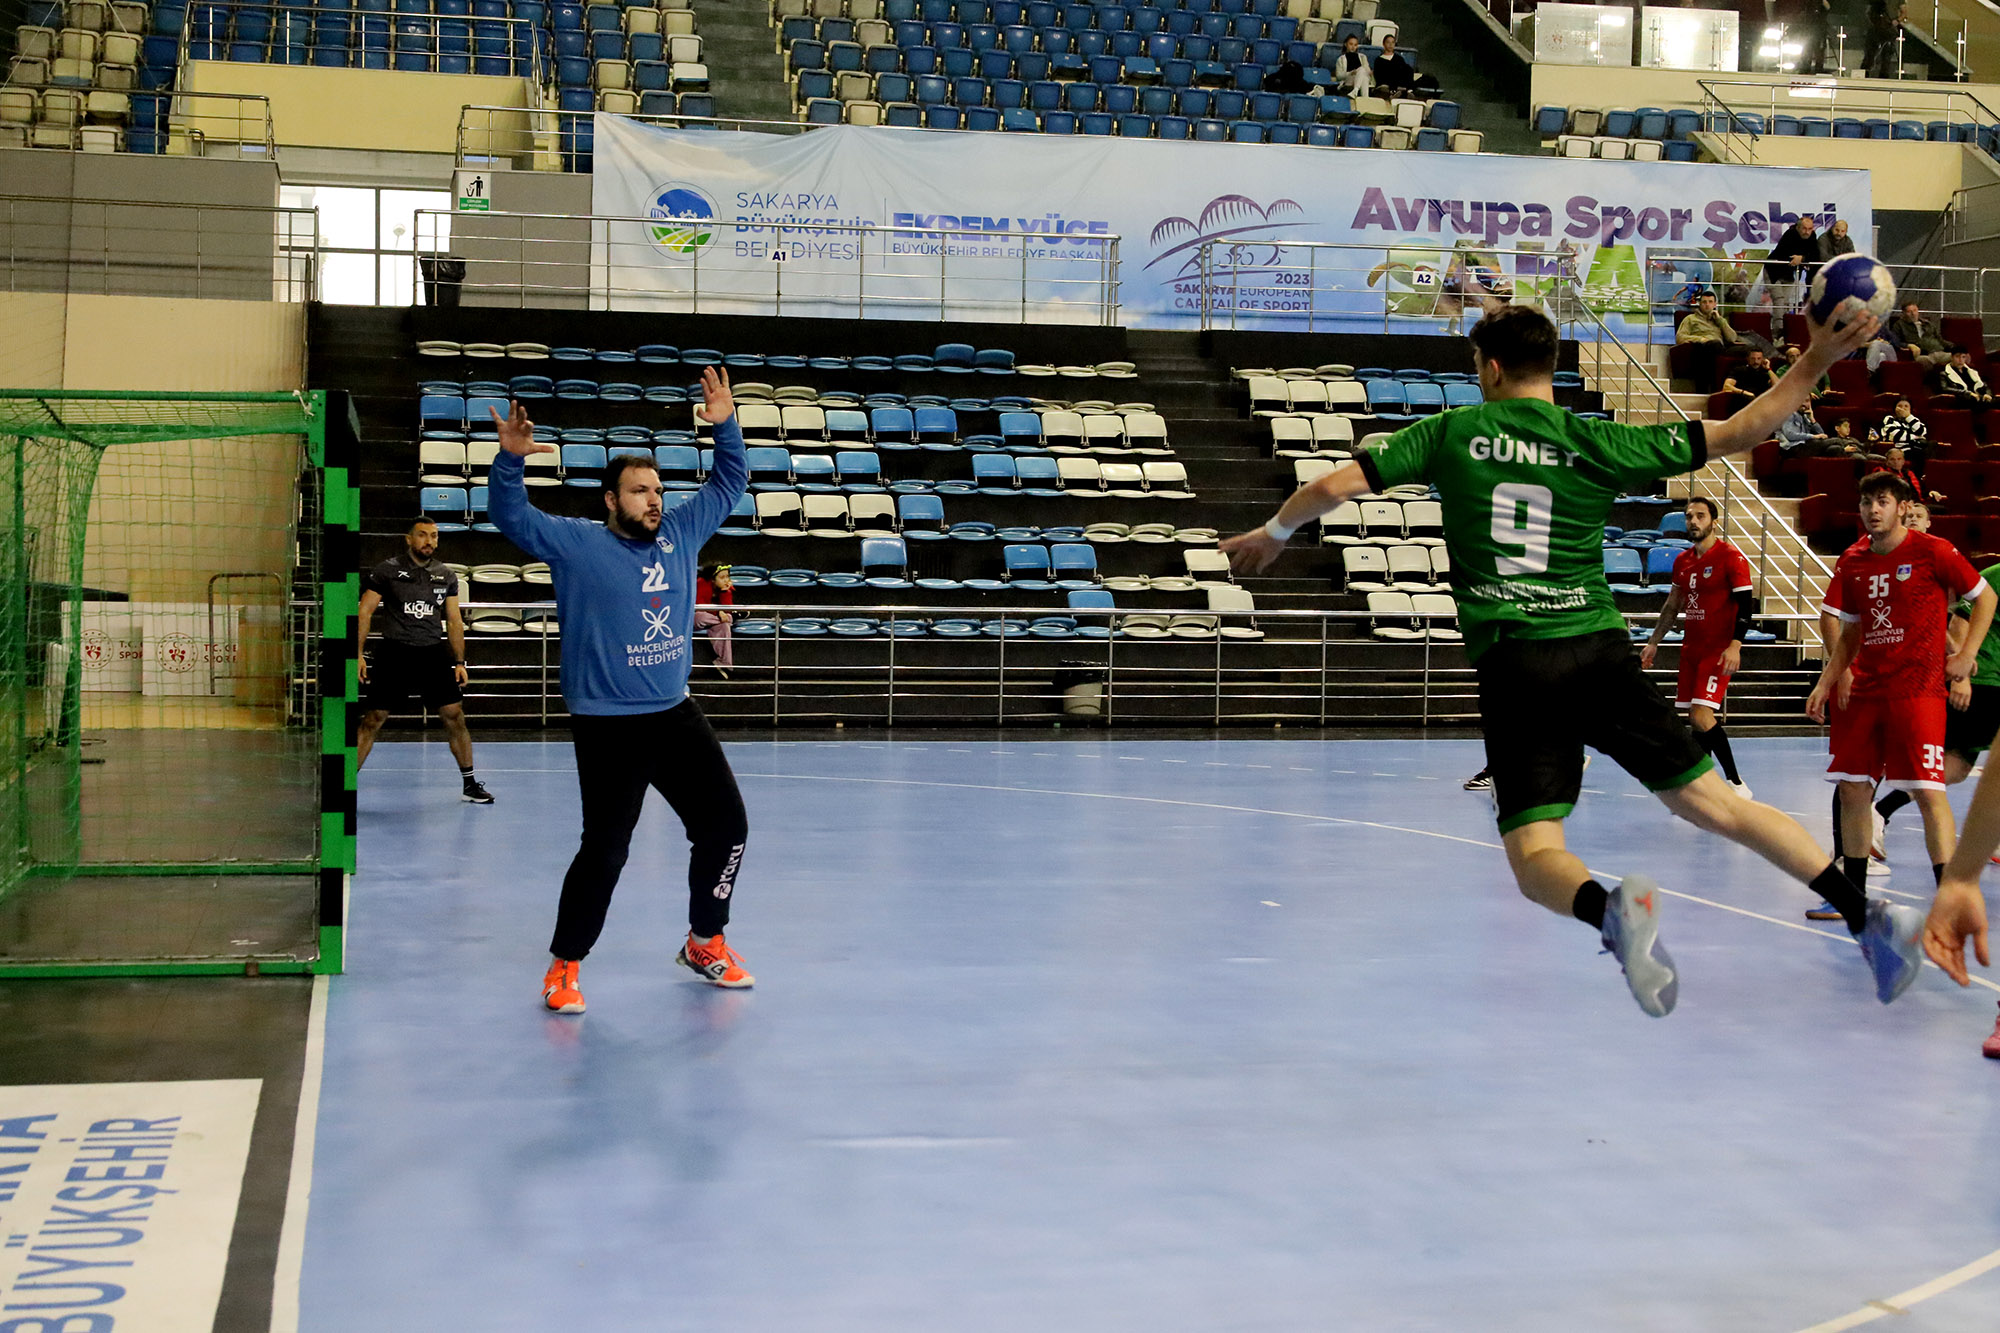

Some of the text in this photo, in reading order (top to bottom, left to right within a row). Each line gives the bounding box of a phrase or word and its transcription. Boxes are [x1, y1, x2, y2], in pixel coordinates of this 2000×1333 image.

[736, 192, 839, 210] SAKARYA
[735, 213, 876, 237] BÜYÜKŞEHİR
[1350, 186, 1553, 245] Avrupa
[1564, 196, 1693, 248] Spor
[893, 212, 1109, 246] EKREM YÜCE
[772, 251, 786, 261] A1
[1274, 273, 1310, 285] 2023
[1416, 274, 1431, 284] A2
[1240, 287, 1311, 298] EUROPEAN
[1239, 299, 1259, 309] OF
[1263, 300, 1310, 311] SPORT
[1468, 433, 1580, 467] GÜNEY
[1490, 482, 1553, 575] 9
[641, 561, 670, 592] 22
[1688, 572, 1697, 588] 6
[1867, 573, 1890, 599] 35
[1706, 675, 1718, 693] 6
[1922, 744, 1944, 770] 35
